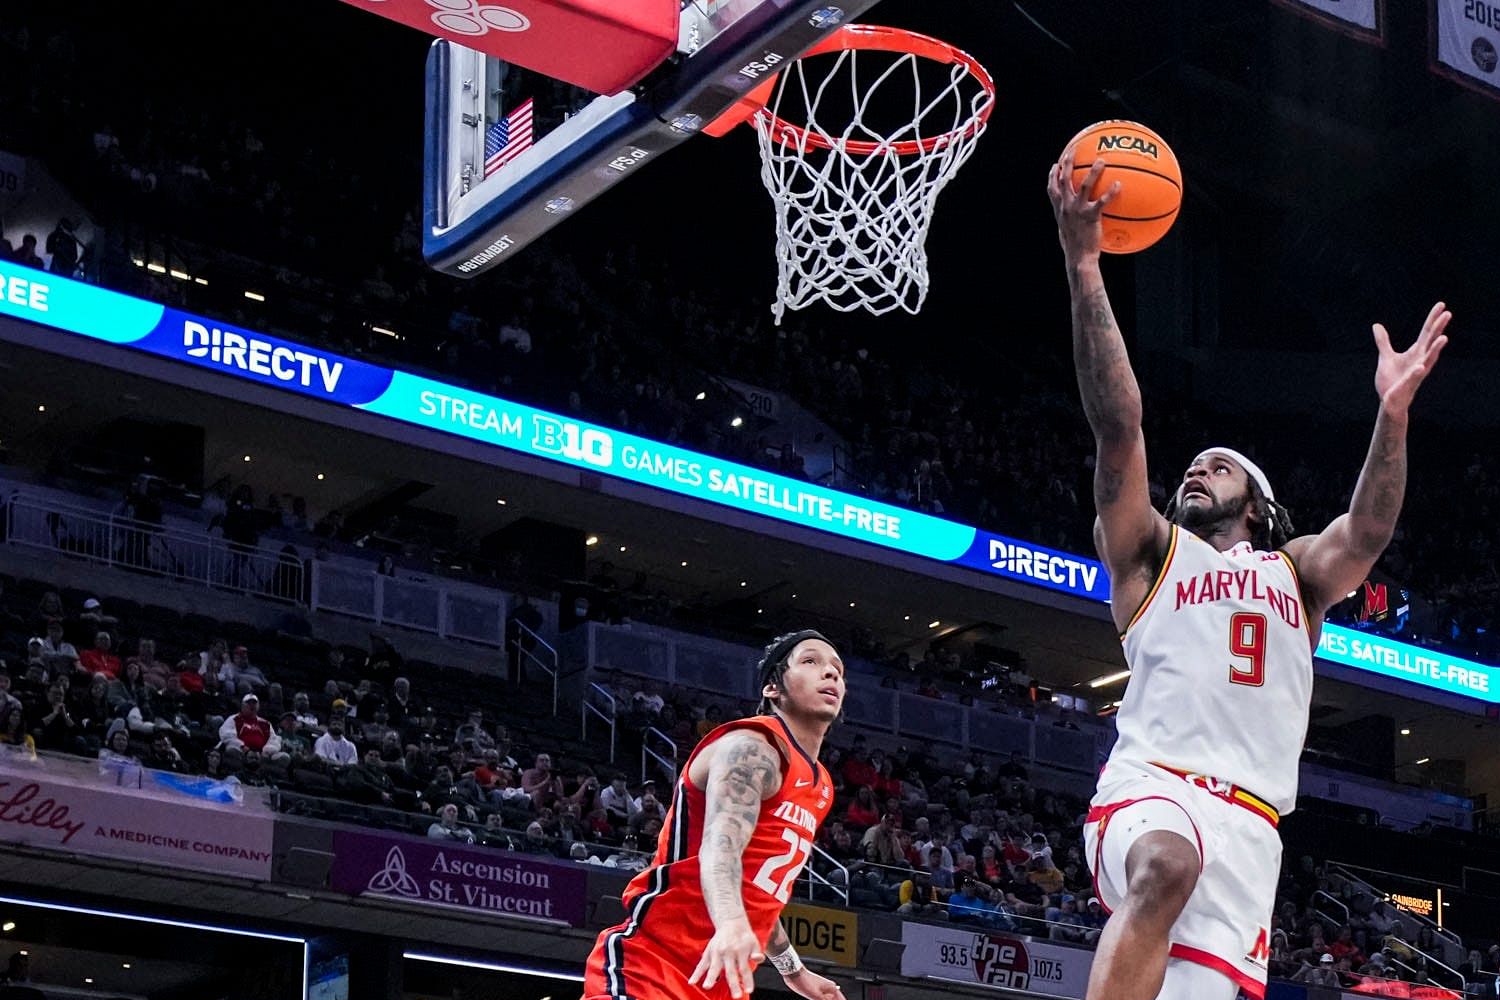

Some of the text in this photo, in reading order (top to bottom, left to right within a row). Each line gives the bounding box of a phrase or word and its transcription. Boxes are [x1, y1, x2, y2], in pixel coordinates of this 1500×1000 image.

[739, 52, 784, 79] IFS.ai
[608, 147, 649, 172] IFS.ai
[1097, 135, 1158, 159] NCAA
[183, 319, 344, 393] DIRECTV
[419, 390, 523, 439] STREAM
[621, 446, 703, 487] GAMES
[708, 468, 902, 540] SATELLITE-FREE
[988, 538, 1098, 593] DIRECTV
[1175, 569, 1300, 629] MARYLND
[1229, 611, 1268, 688] 9
[1318, 631, 1490, 693] MES SATELLITE-FREE
[0, 783, 272, 863] Lilly A MEDICINE COMPANY
[430, 851, 550, 889] Ascension
[428, 880, 553, 918] St. Vincent
[786, 914, 846, 953] IDGE
[971, 933, 1017, 965] the
[940, 945, 968, 966] 93.5
[1033, 958, 1063, 981] 107.5
[982, 965, 1031, 990] fan
